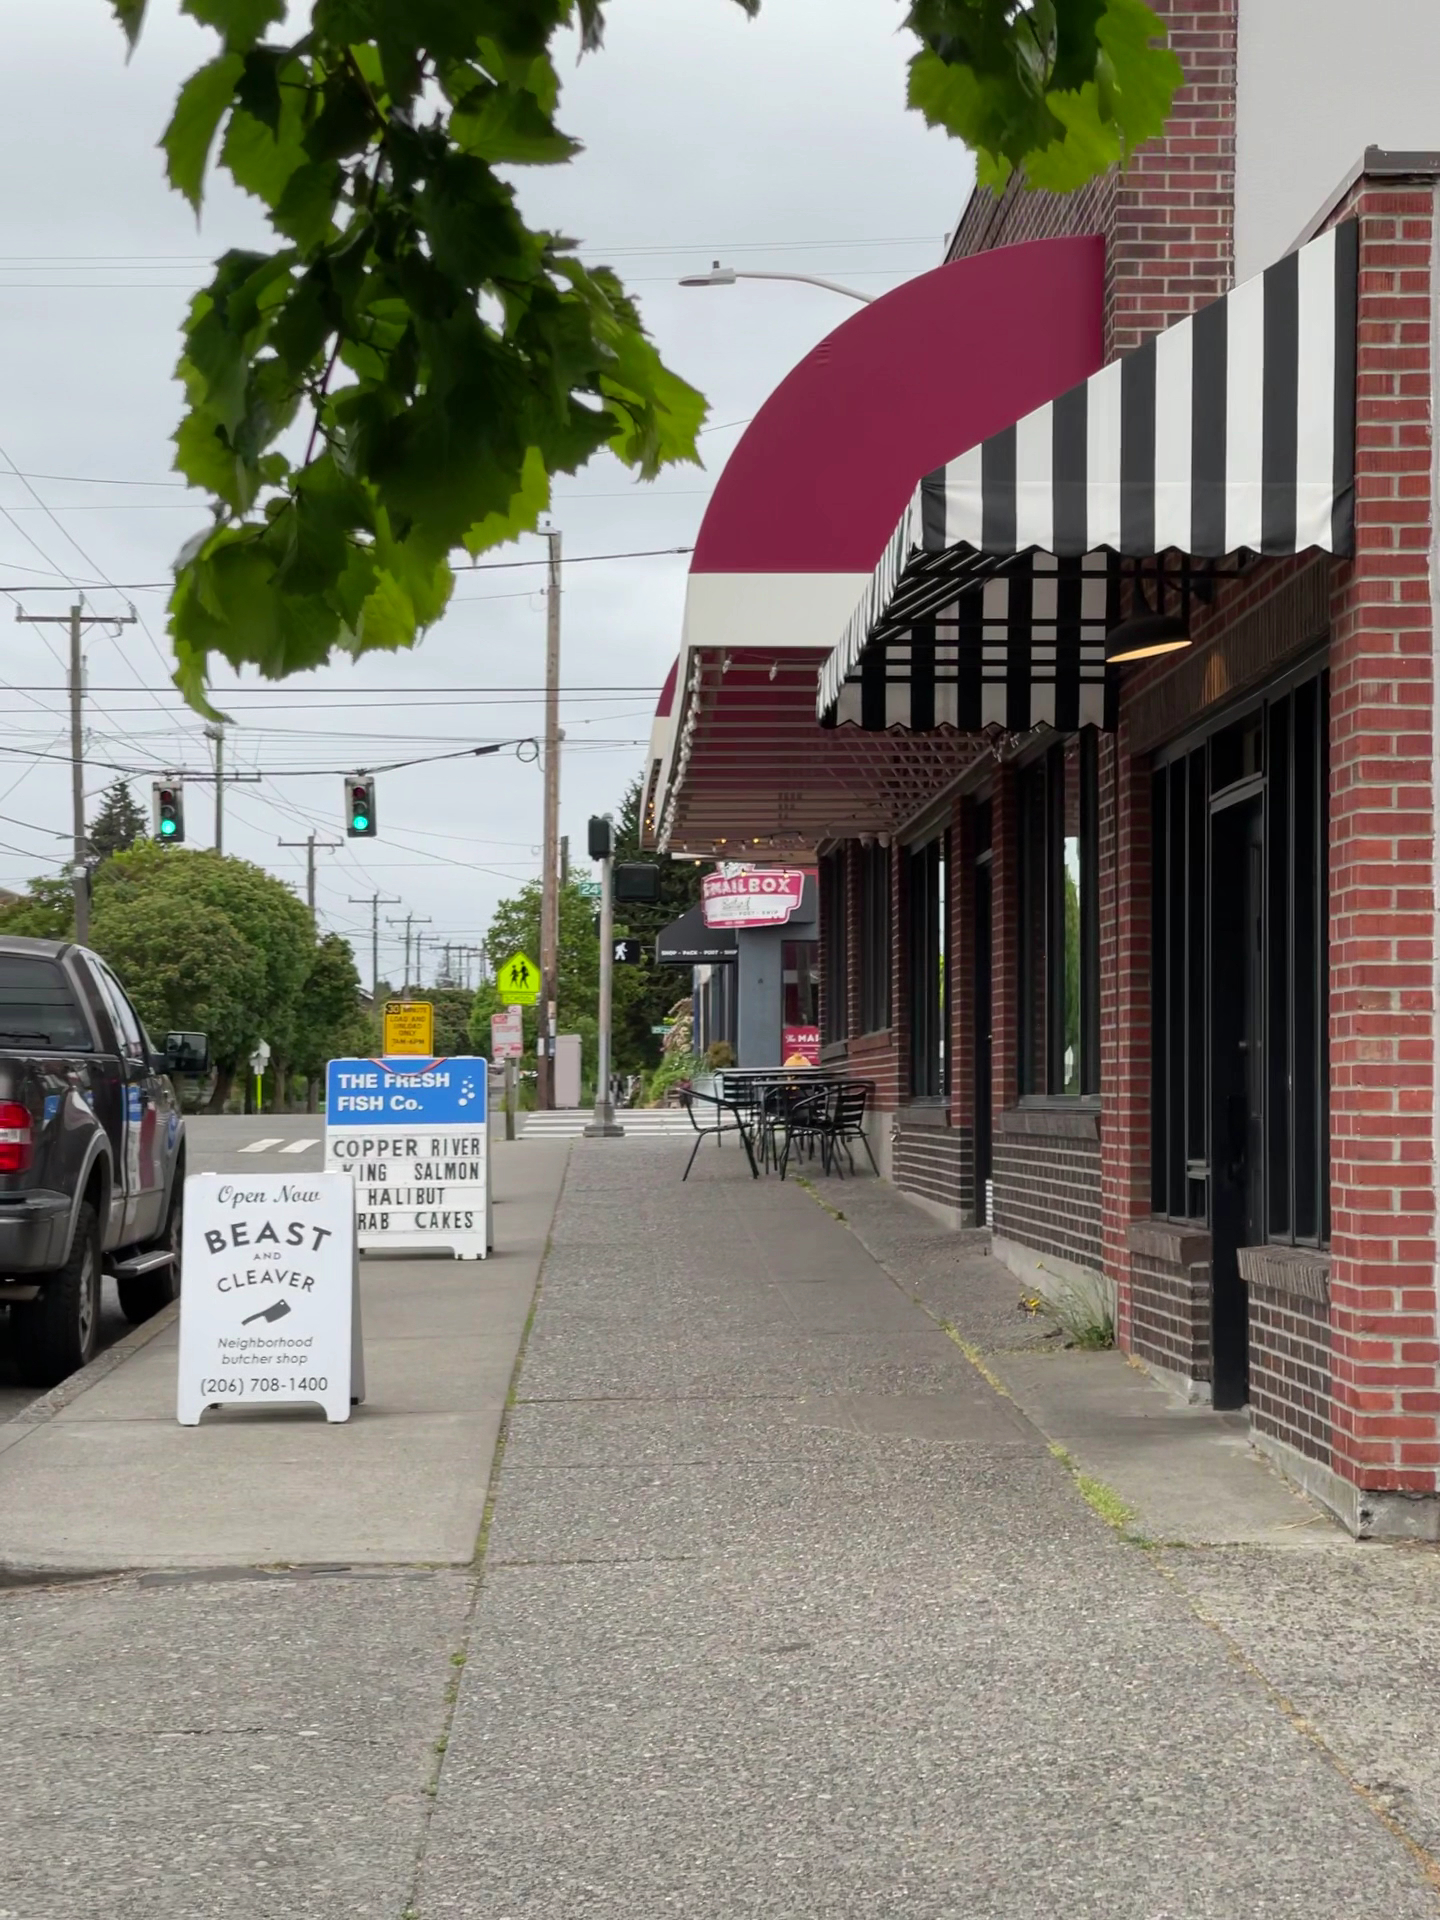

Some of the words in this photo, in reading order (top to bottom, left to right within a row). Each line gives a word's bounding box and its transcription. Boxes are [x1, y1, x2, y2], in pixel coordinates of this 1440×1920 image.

[582, 884, 598, 894] 24
[388, 1004, 399, 1013] 30
[797, 1034, 819, 1042] MAI
[338, 1074, 378, 1089] THE
[384, 1072, 450, 1089] FRESH
[337, 1096, 383, 1111] FISH
[390, 1095, 424, 1111] Co.
[333, 1139, 418, 1158] COPPER
[431, 1138, 480, 1156] RIVER
[414, 1162, 479, 1180] SALMON
[217, 1185, 266, 1208] Open
[273, 1184, 321, 1204] Now
[368, 1187, 445, 1206] HALIBUT
[357, 1213, 390, 1230] RAB
[415, 1211, 473, 1229] CAKES
[204, 1221, 332, 1254] BEAST
[253, 1252, 282, 1261] AND
[217, 1269, 315, 1293] CLEAVER
[217, 1336, 313, 1351] Neighborhood
[221, 1353, 274, 1366] butcher
[276, 1353, 308, 1367] shop
[201, 1377, 244, 1395] (206)
[250, 1377, 328, 1393] 708-1400
